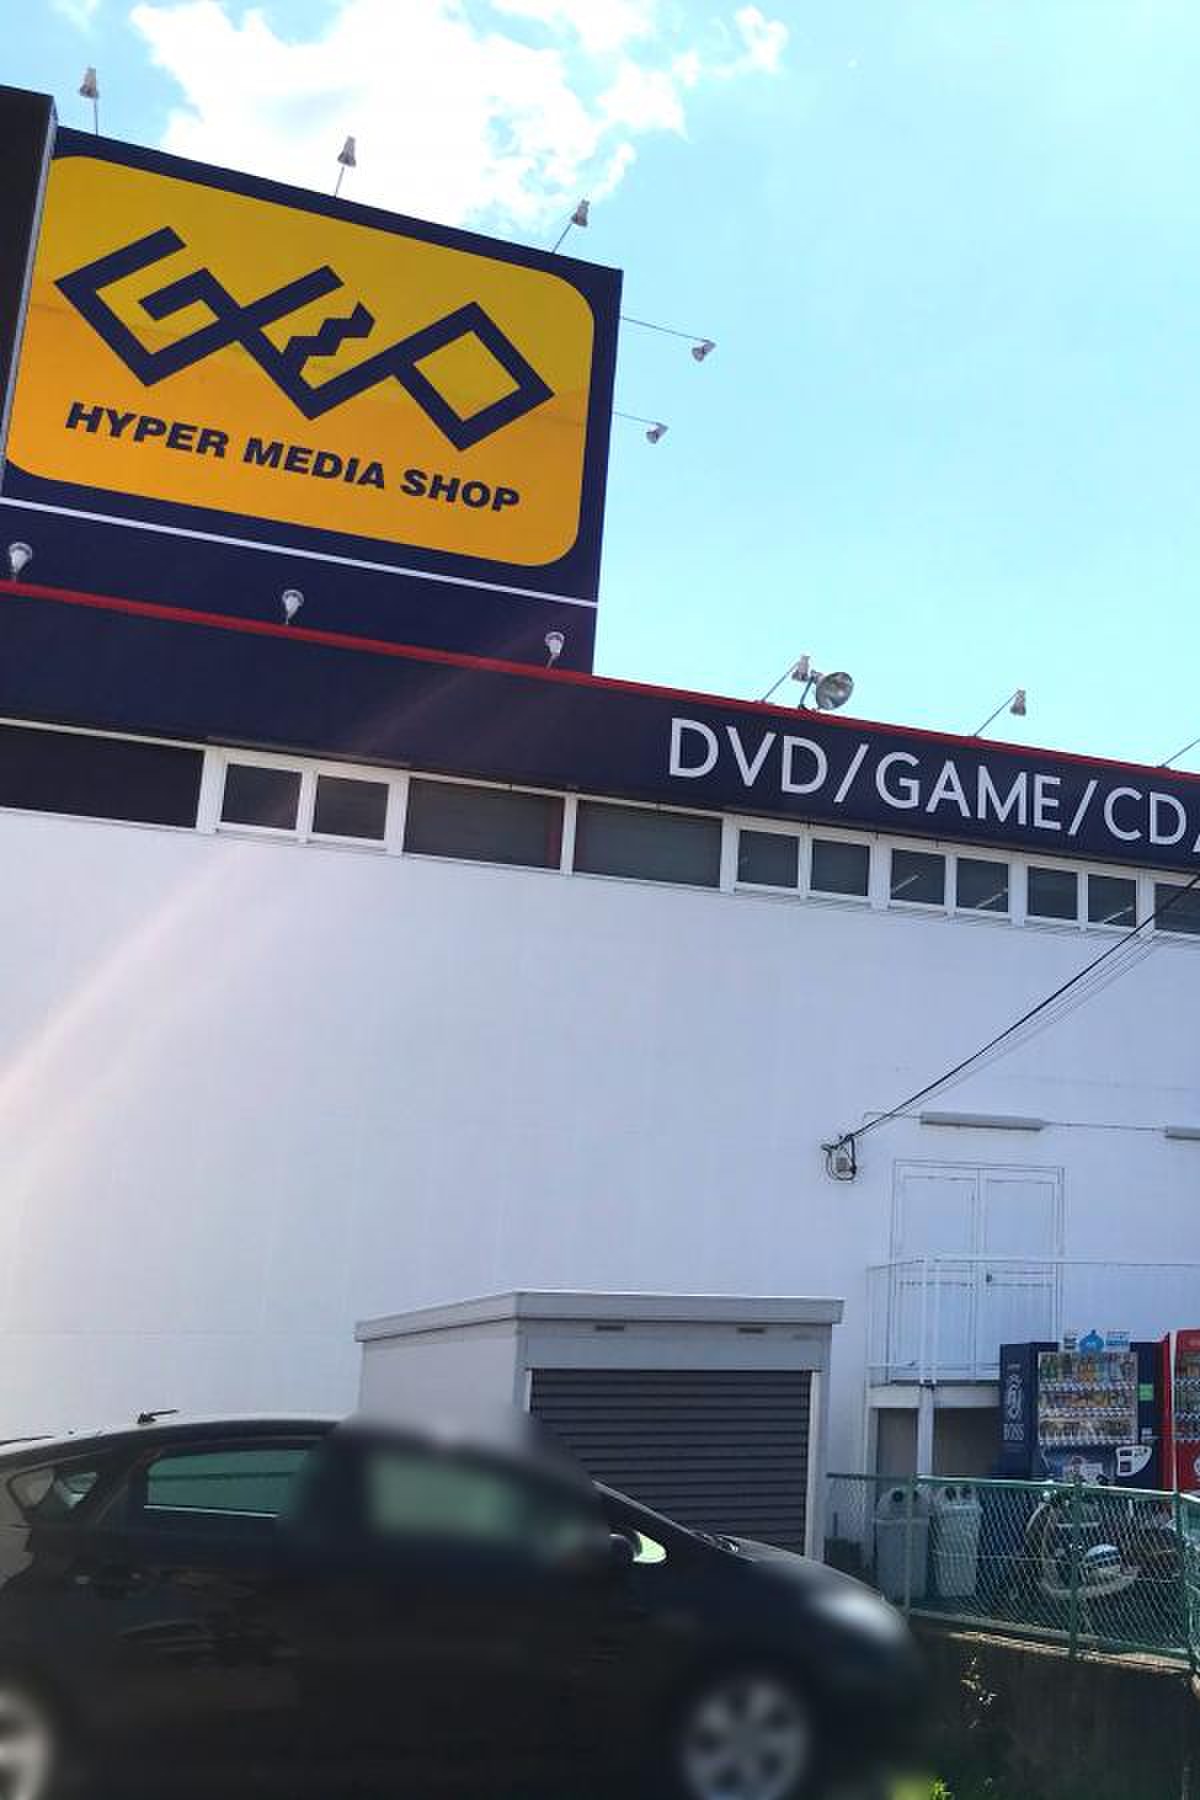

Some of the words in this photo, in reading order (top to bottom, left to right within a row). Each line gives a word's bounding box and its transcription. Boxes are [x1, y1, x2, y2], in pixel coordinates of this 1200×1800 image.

[64, 401, 230, 458] HYPER
[242, 437, 386, 489] MEDIA
[399, 468, 521, 513] SHOP
